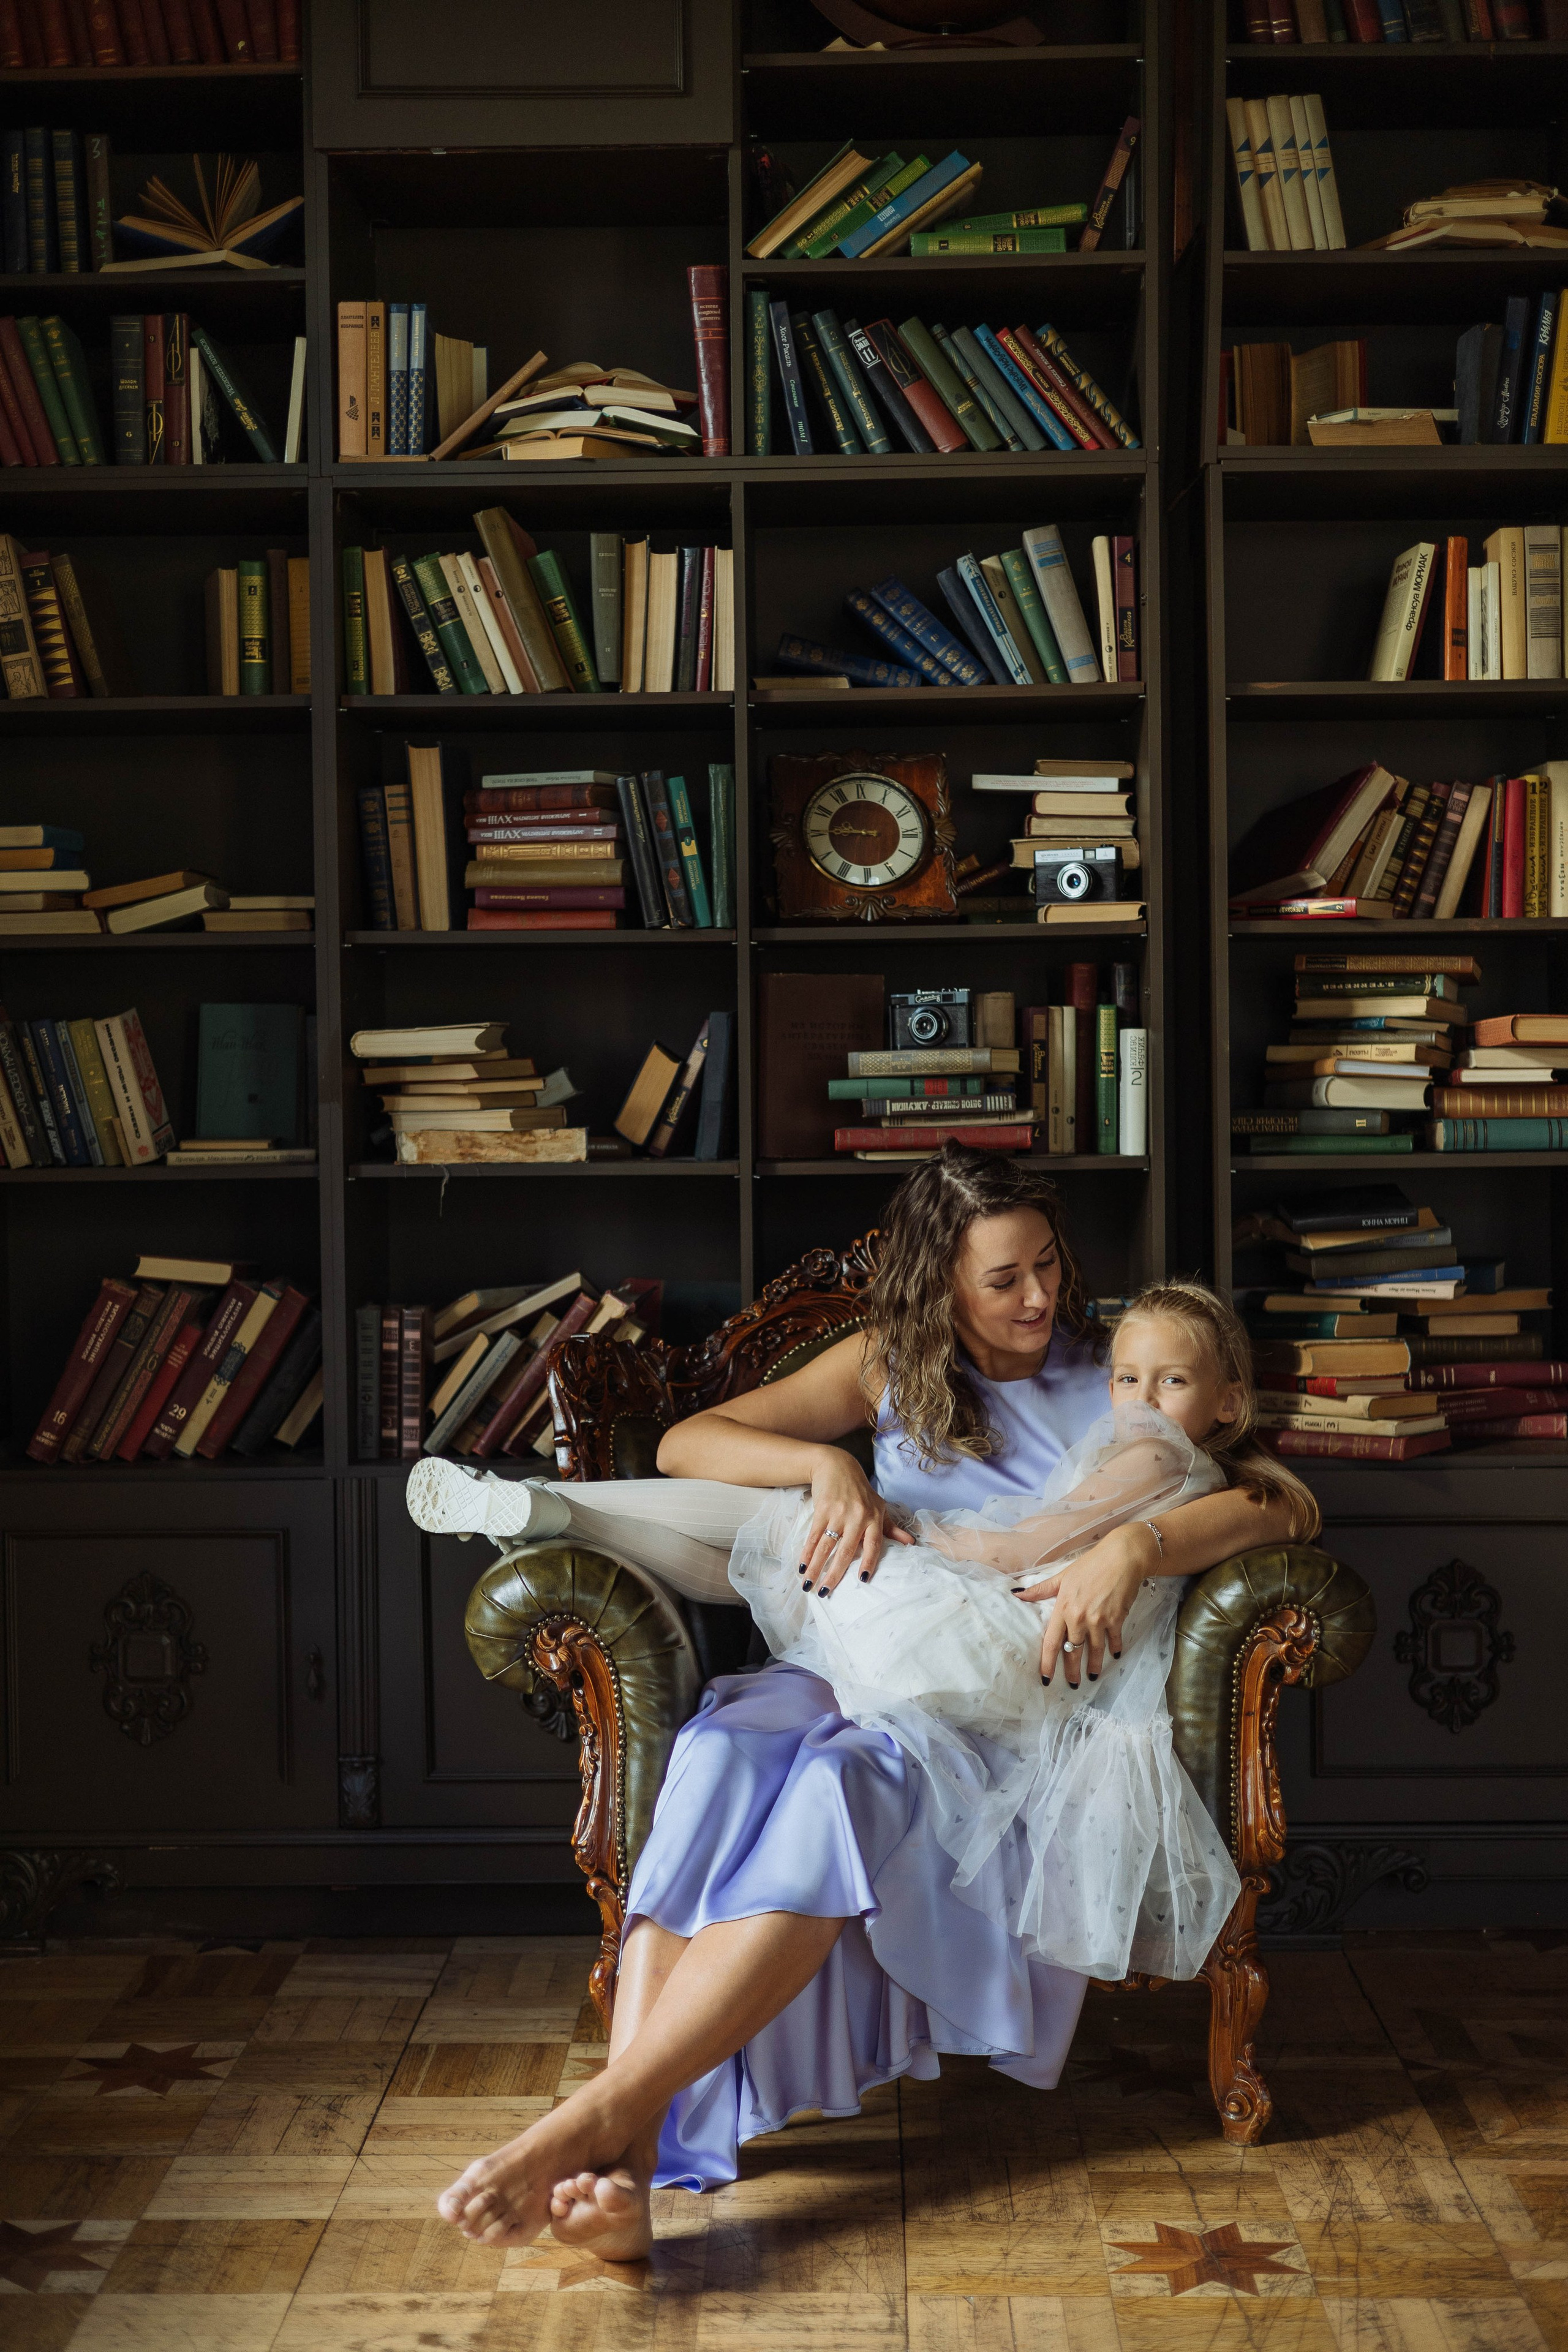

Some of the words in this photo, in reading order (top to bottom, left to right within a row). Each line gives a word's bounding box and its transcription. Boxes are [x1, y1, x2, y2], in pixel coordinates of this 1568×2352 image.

[1092, 199, 1107, 220] Вадим
[1093, 192, 1117, 229] Кожевников
[778, 325, 788, 342] Хосе
[855, 338, 870, 351] ЗОЛЯ
[197, 337, 219, 366] алмазов
[371, 332, 379, 391] ПАНТЕЛЕЕВ
[782, 342, 793, 367] Рисаль
[861, 347, 875, 362] 11
[1034, 347, 1049, 366] поэмы
[213, 364, 236, 396] Искатели
[809, 351, 831, 398] Татьяничева
[835, 350, 862, 398] Татьяничева
[1050, 367, 1066, 388] Стихи
[788, 379, 799, 407] Сочинения
[1529, 385, 1542, 427] ВЛАДИМИР
[1536, 353, 1546, 384] СОСЮРА
[826, 398, 845, 432] Людмила
[855, 397, 875, 431] Людмила
[1556, 402, 1565, 435] ПОВЕСТИ
[797, 421, 807, 437] том
[1125, 553, 1130, 562] 4
[1410, 552, 1430, 591] МОРИАК
[1510, 569, 1518, 595] НАЦУМЭ
[986, 605, 1004, 633] НИКОЛАЙ
[1403, 592, 1423, 631] Франсуа
[1124, 611, 1134, 647] Кожевников
[488, 814, 513, 824] XVIII
[494, 829, 521, 839] XVIII
[902, 827, 918, 839] XII
[1322, 979, 1394, 991] В.ТЕККЕРЕЙ
[104, 1023, 119, 1062] ОКЕАНИИ
[116, 1065, 128, 1093] МИФЫ
[1131, 1071, 1141, 1085] 2
[891, 1101, 928, 1111] ДЖУНГЛИ
[931, 1100, 959, 1109] СИНКЛЕР
[961, 1099, 981, 1108] ЭПТОН
[127, 1104, 141, 1139] СКАЗКИ
[1232, 1124, 1298, 1133] ЛИТЕРАТУРНАЯ
[79, 1333, 99, 1360] БОЛЬШАЯ
[91, 1300, 115, 1333] СОВЕТСКАЯ
[83, 1303, 124, 1363] ЭНЦИКЛОПЕДИЯ
[202, 1329, 220, 1356] БОЛЬШАЯ
[216, 1298, 237, 1330] СОВЕТСКАЯ
[208, 1301, 244, 1360] ЭНЦИКЛОПЕДИЯ
[145, 1351, 159, 1371] 6
[52, 1409, 67, 1425] 16
[167, 1402, 187, 1422] 29
